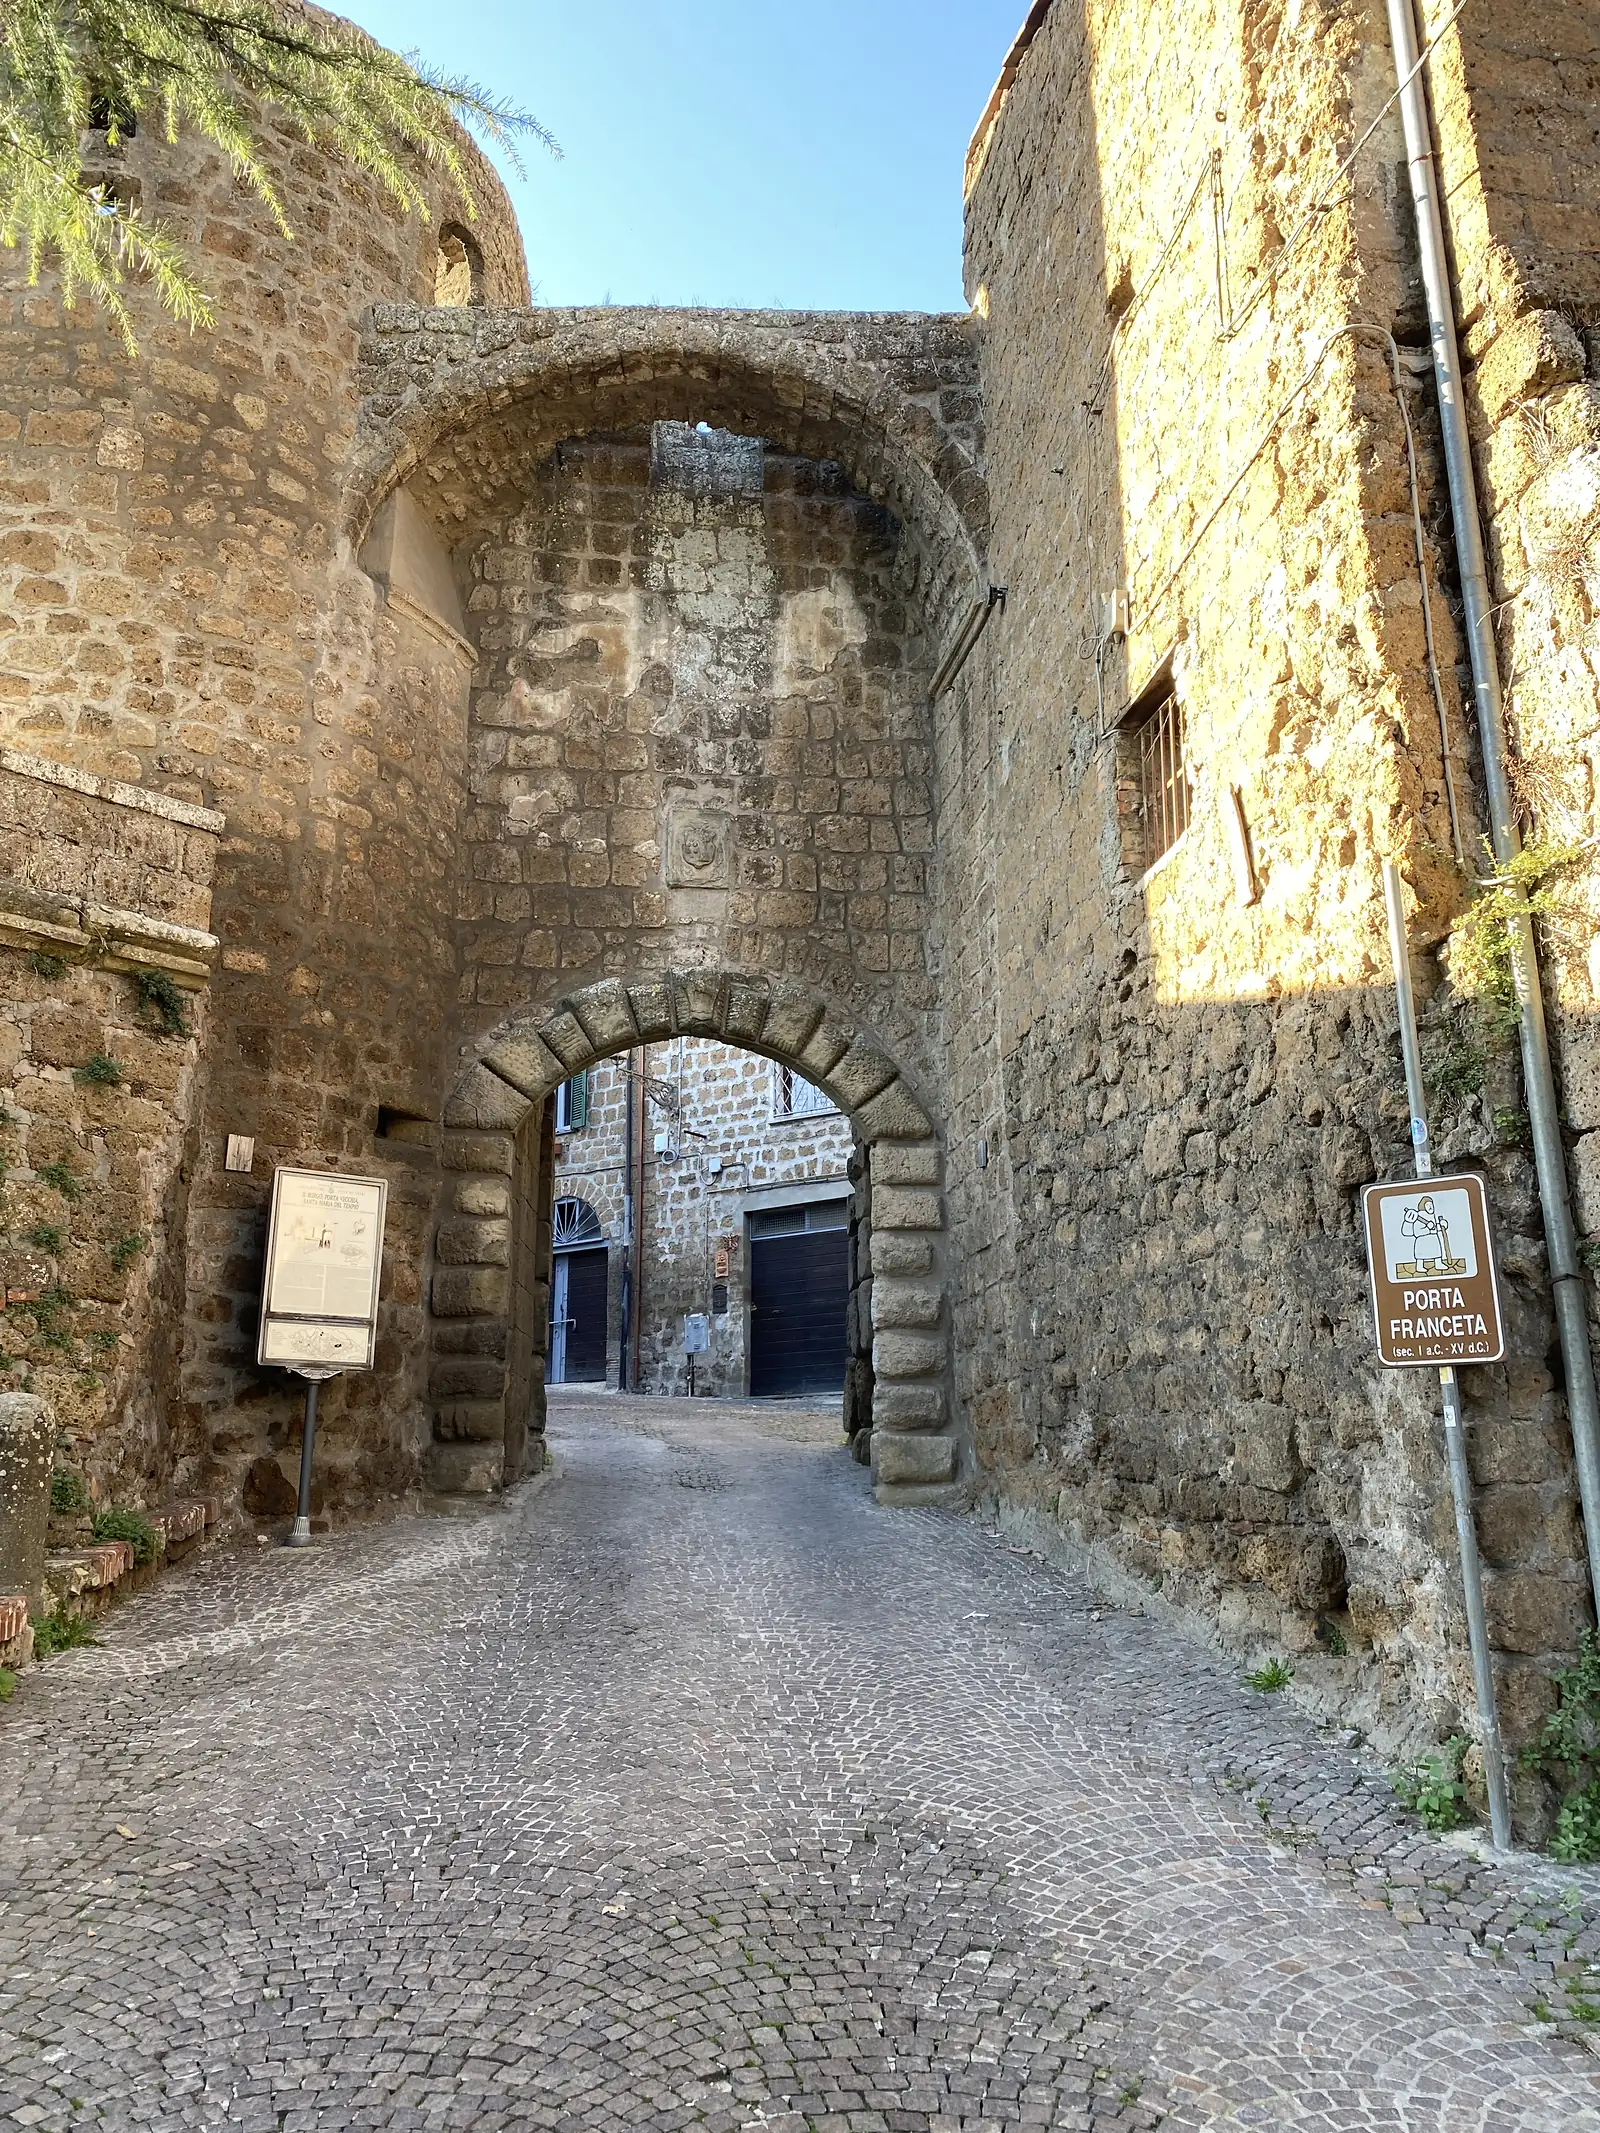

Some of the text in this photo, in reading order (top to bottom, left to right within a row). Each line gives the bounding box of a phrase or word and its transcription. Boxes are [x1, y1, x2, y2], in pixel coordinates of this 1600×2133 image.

[1403, 1287, 1465, 1311] PORTA
[1390, 1313, 1488, 1340] FRANCETA
[1393, 1346, 1415, 1357] (sec.
[1426, 1344, 1444, 1355] a.C.
[1450, 1342, 1464, 1355] XV
[1468, 1341, 1489, 1353] d.C.)
